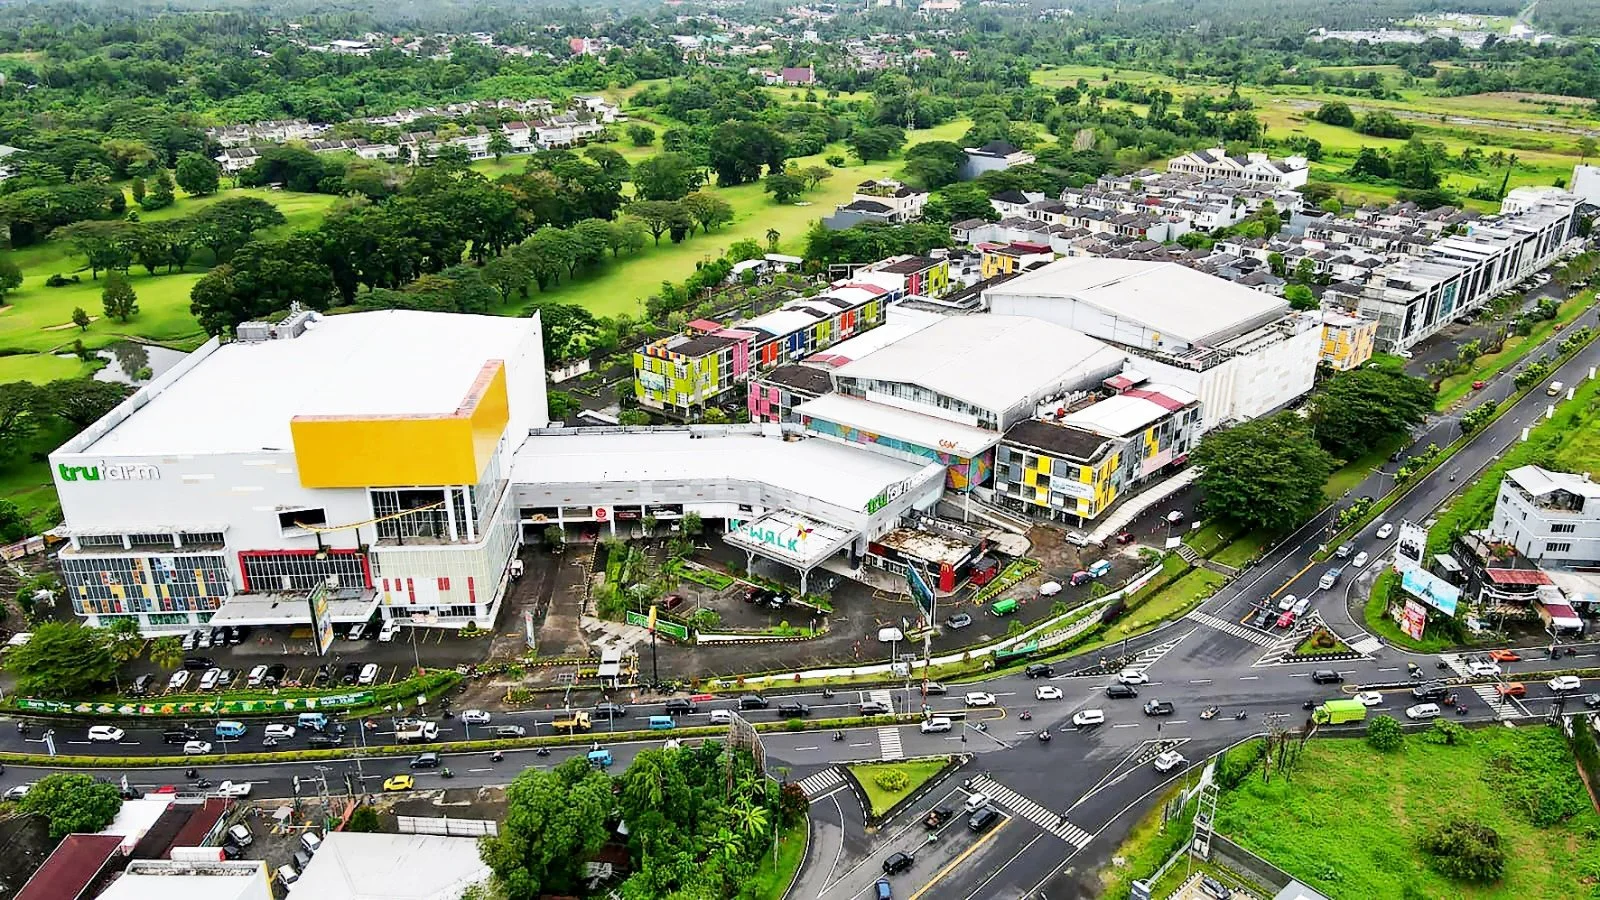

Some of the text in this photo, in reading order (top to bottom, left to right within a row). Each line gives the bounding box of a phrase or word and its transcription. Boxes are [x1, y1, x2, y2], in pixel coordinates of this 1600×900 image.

[58, 459, 161, 481] trufarm
[867, 473, 926, 514] trufar
[730, 518, 798, 552] K-WALK
